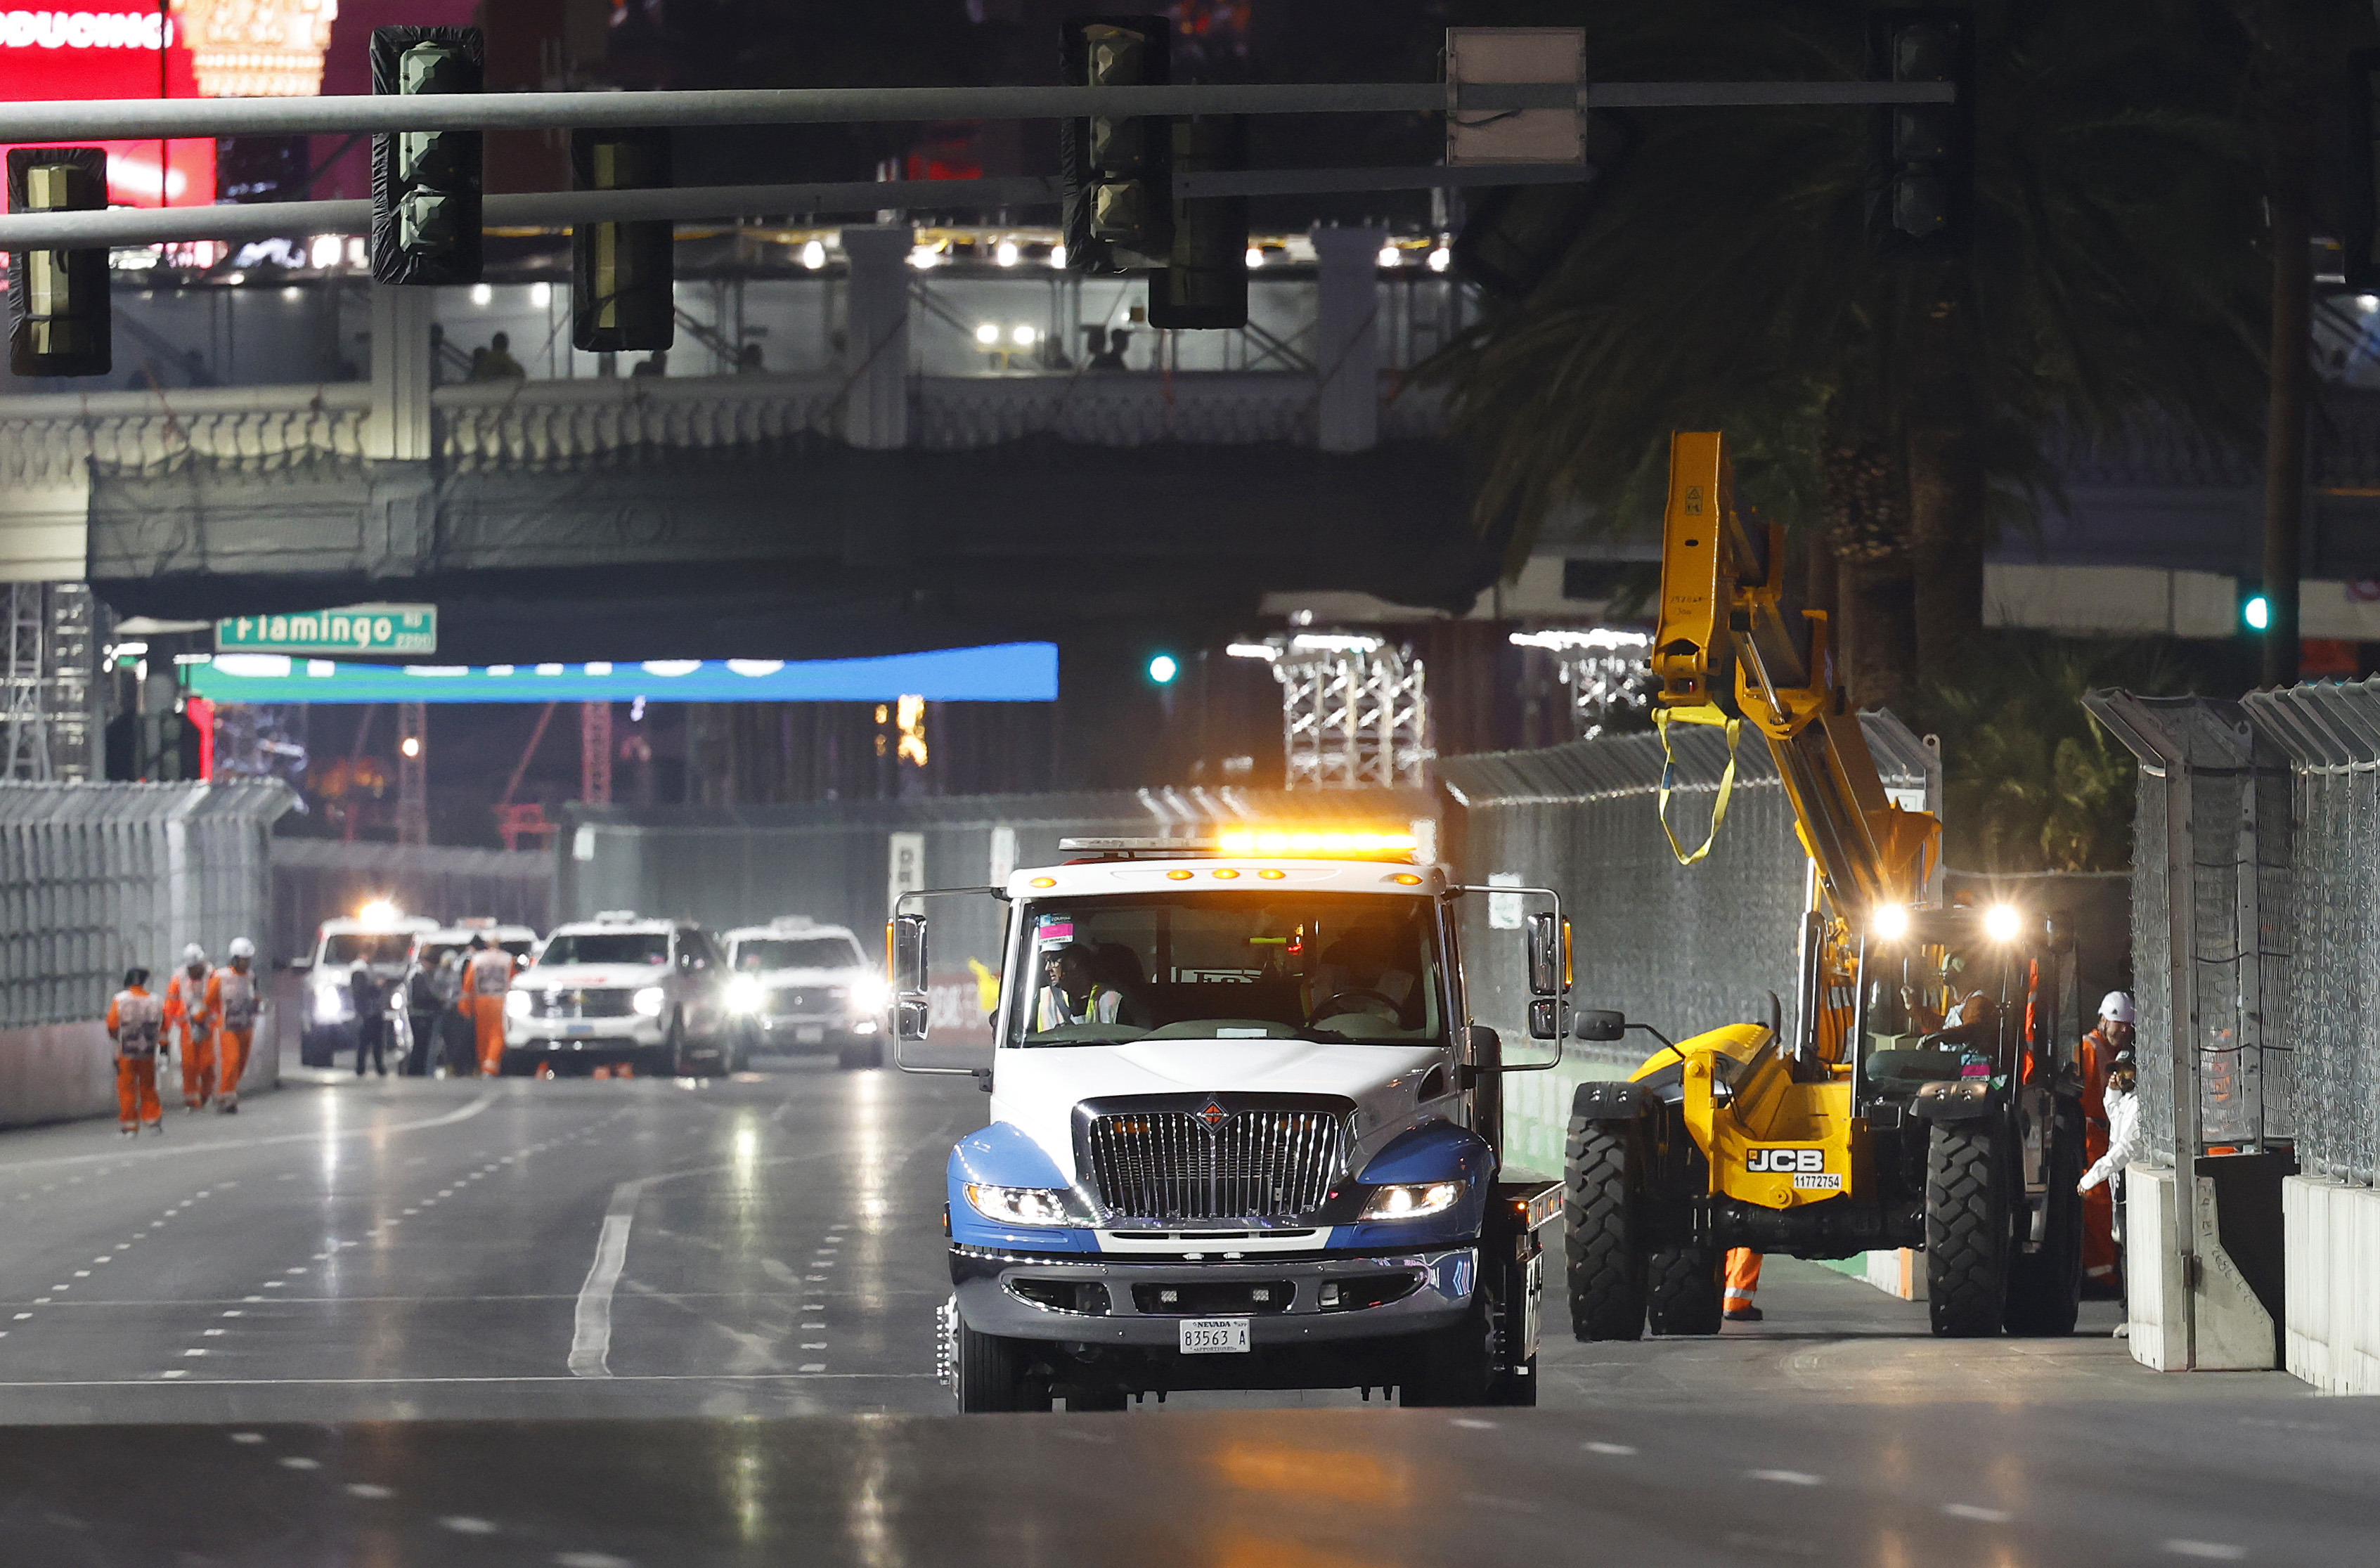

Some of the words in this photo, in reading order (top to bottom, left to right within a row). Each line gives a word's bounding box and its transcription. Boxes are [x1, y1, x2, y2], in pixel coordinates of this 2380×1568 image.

[236, 610, 392, 649] Flamingo
[1748, 1150, 1823, 1172] JCB
[1794, 1175, 1839, 1188] 11772754
[1184, 1330, 1228, 1346] 83563
[1238, 1330, 1246, 1345] A
